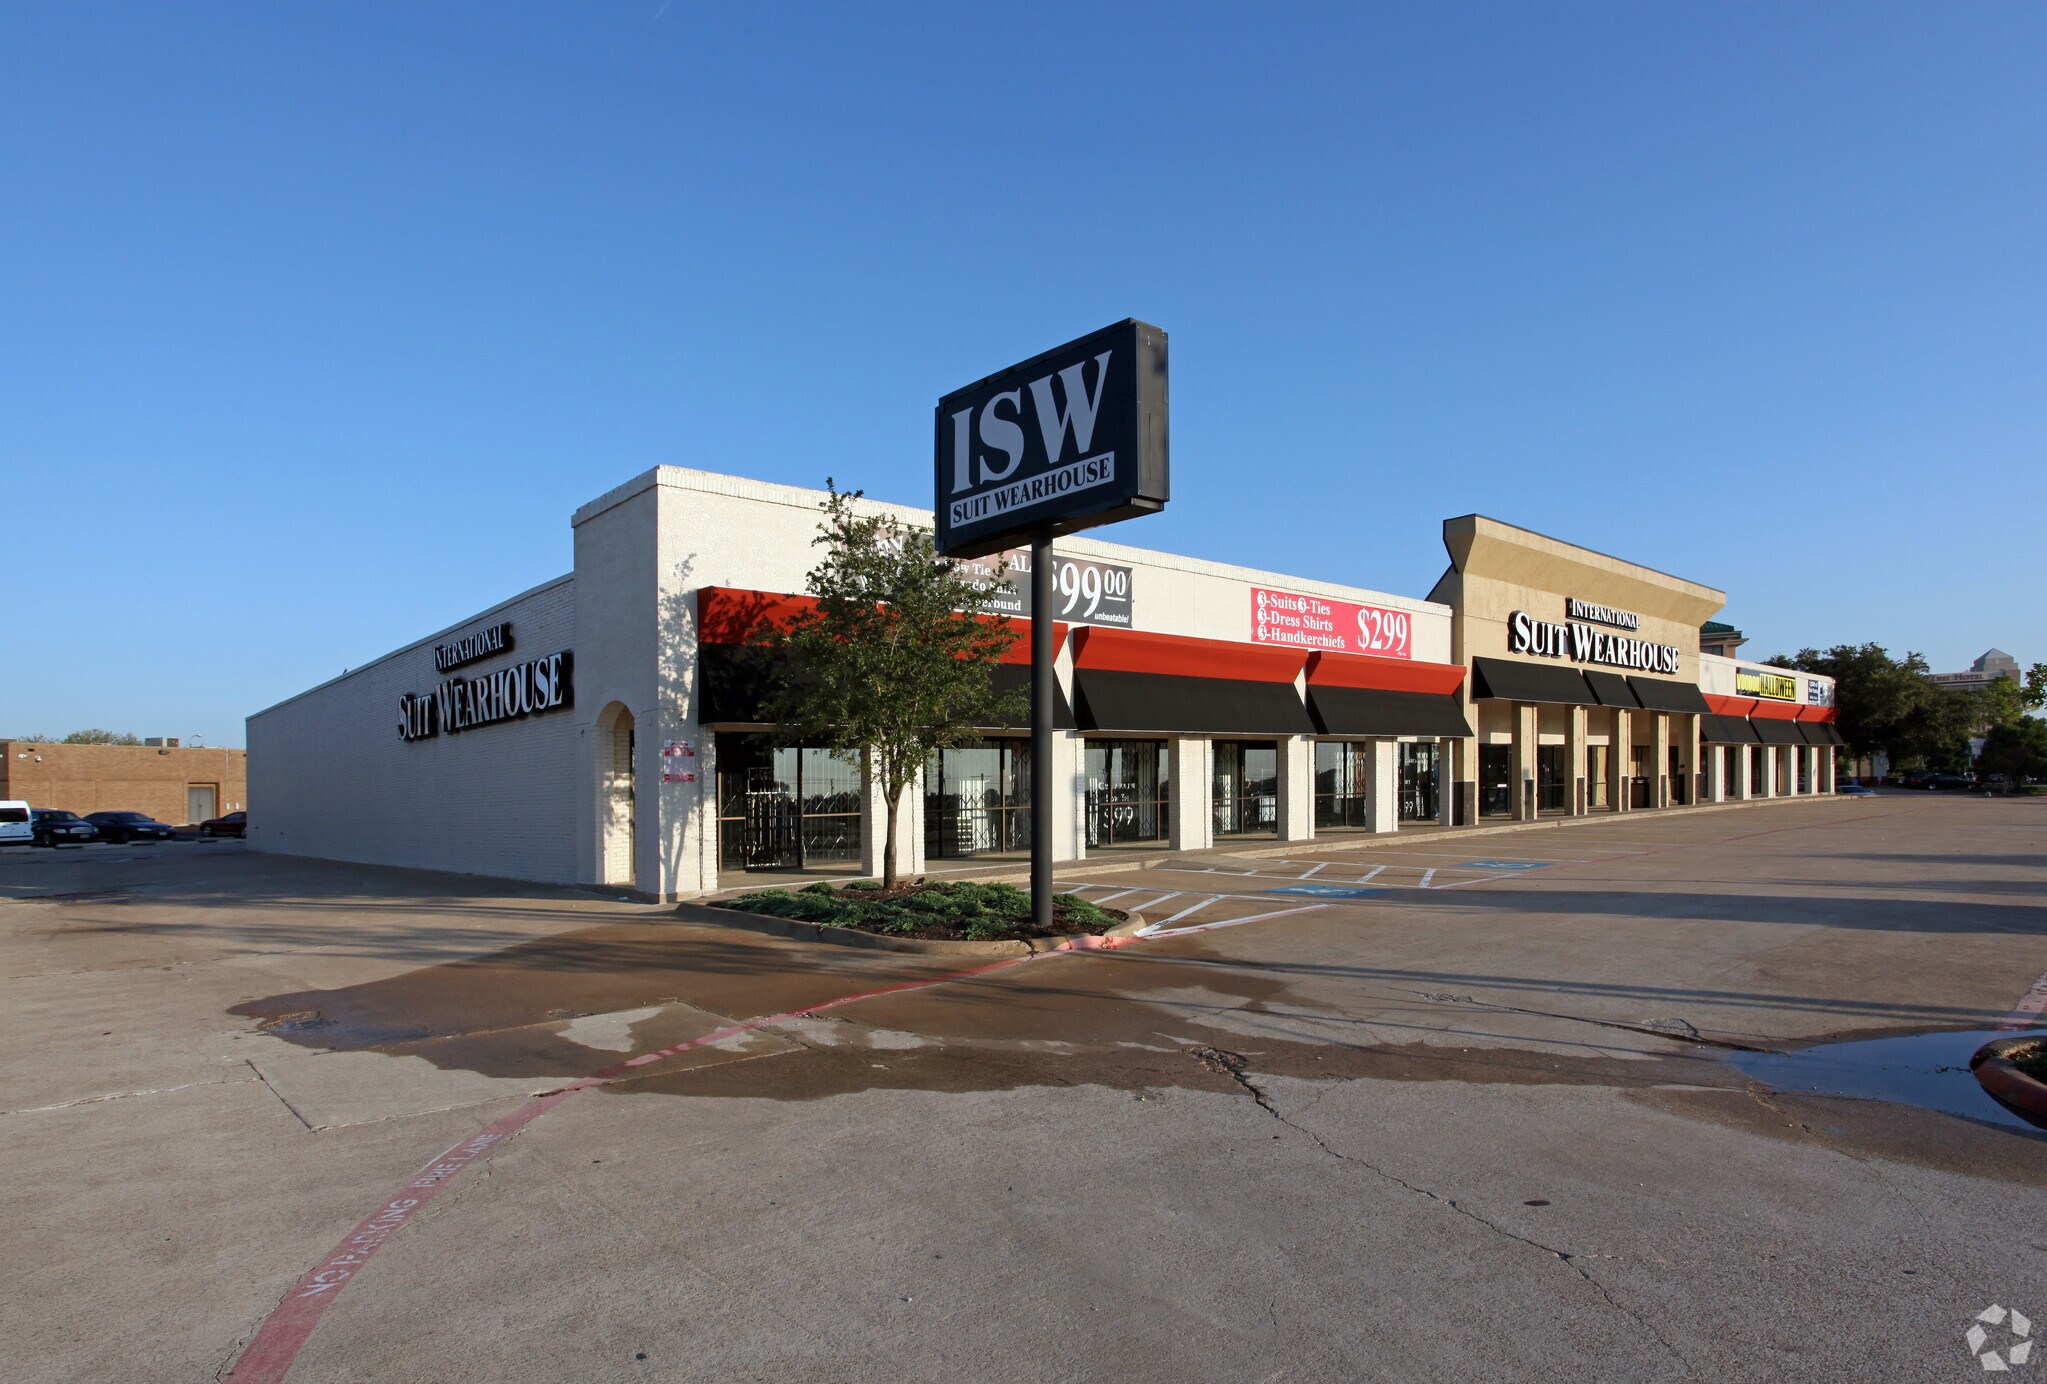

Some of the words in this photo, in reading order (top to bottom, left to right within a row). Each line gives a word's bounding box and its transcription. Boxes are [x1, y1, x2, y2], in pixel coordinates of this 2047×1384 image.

[951, 350, 1112, 495] ISW
[953, 496, 990, 524] SUIT
[995, 456, 1111, 510] WEARHOUSE
[972, 563, 991, 576] Tie
[1303, 615, 1333, 632] Shirts
[1357, 607, 1408, 652] $299
[1572, 598, 1641, 629] INTERNATIONAL
[433, 623, 504, 671] INTERNATIONAL
[1515, 611, 1569, 656] SUIT
[1573, 623, 1680, 673] WEARHOUSE
[398, 694, 432, 740] SUIT
[435, 652, 563, 733] WEARHOUSE
[1761, 675, 1795, 699] HALLOWEEN
